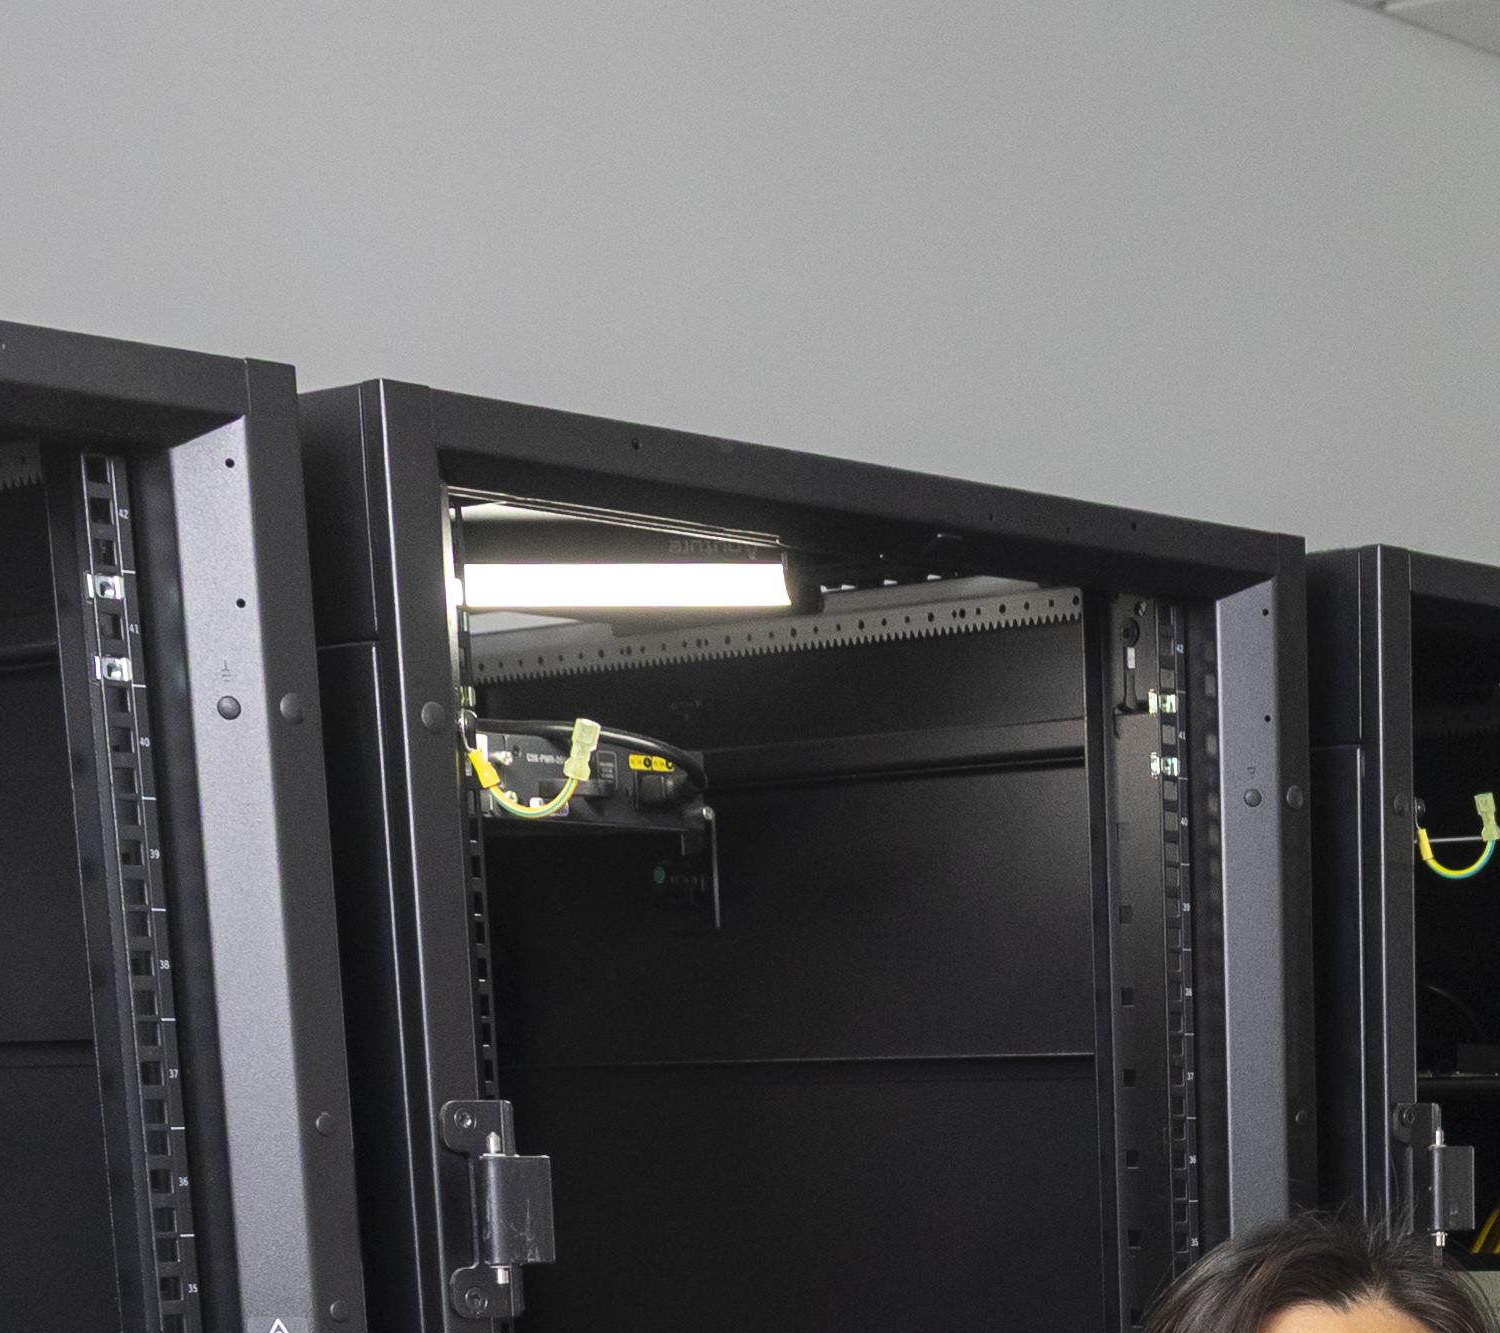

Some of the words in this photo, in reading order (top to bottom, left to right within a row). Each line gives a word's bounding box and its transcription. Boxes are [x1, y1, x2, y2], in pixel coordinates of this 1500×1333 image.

[118, 509, 129, 519] 42
[128, 623, 139, 634] 41
[139, 737, 150, 748] 40
[149, 848, 159, 858] 39
[159, 959, 169, 969] 38
[168, 1068, 178, 1078] 37
[178, 1177, 188, 1187] 36
[187, 1283, 197, 1293] 35
